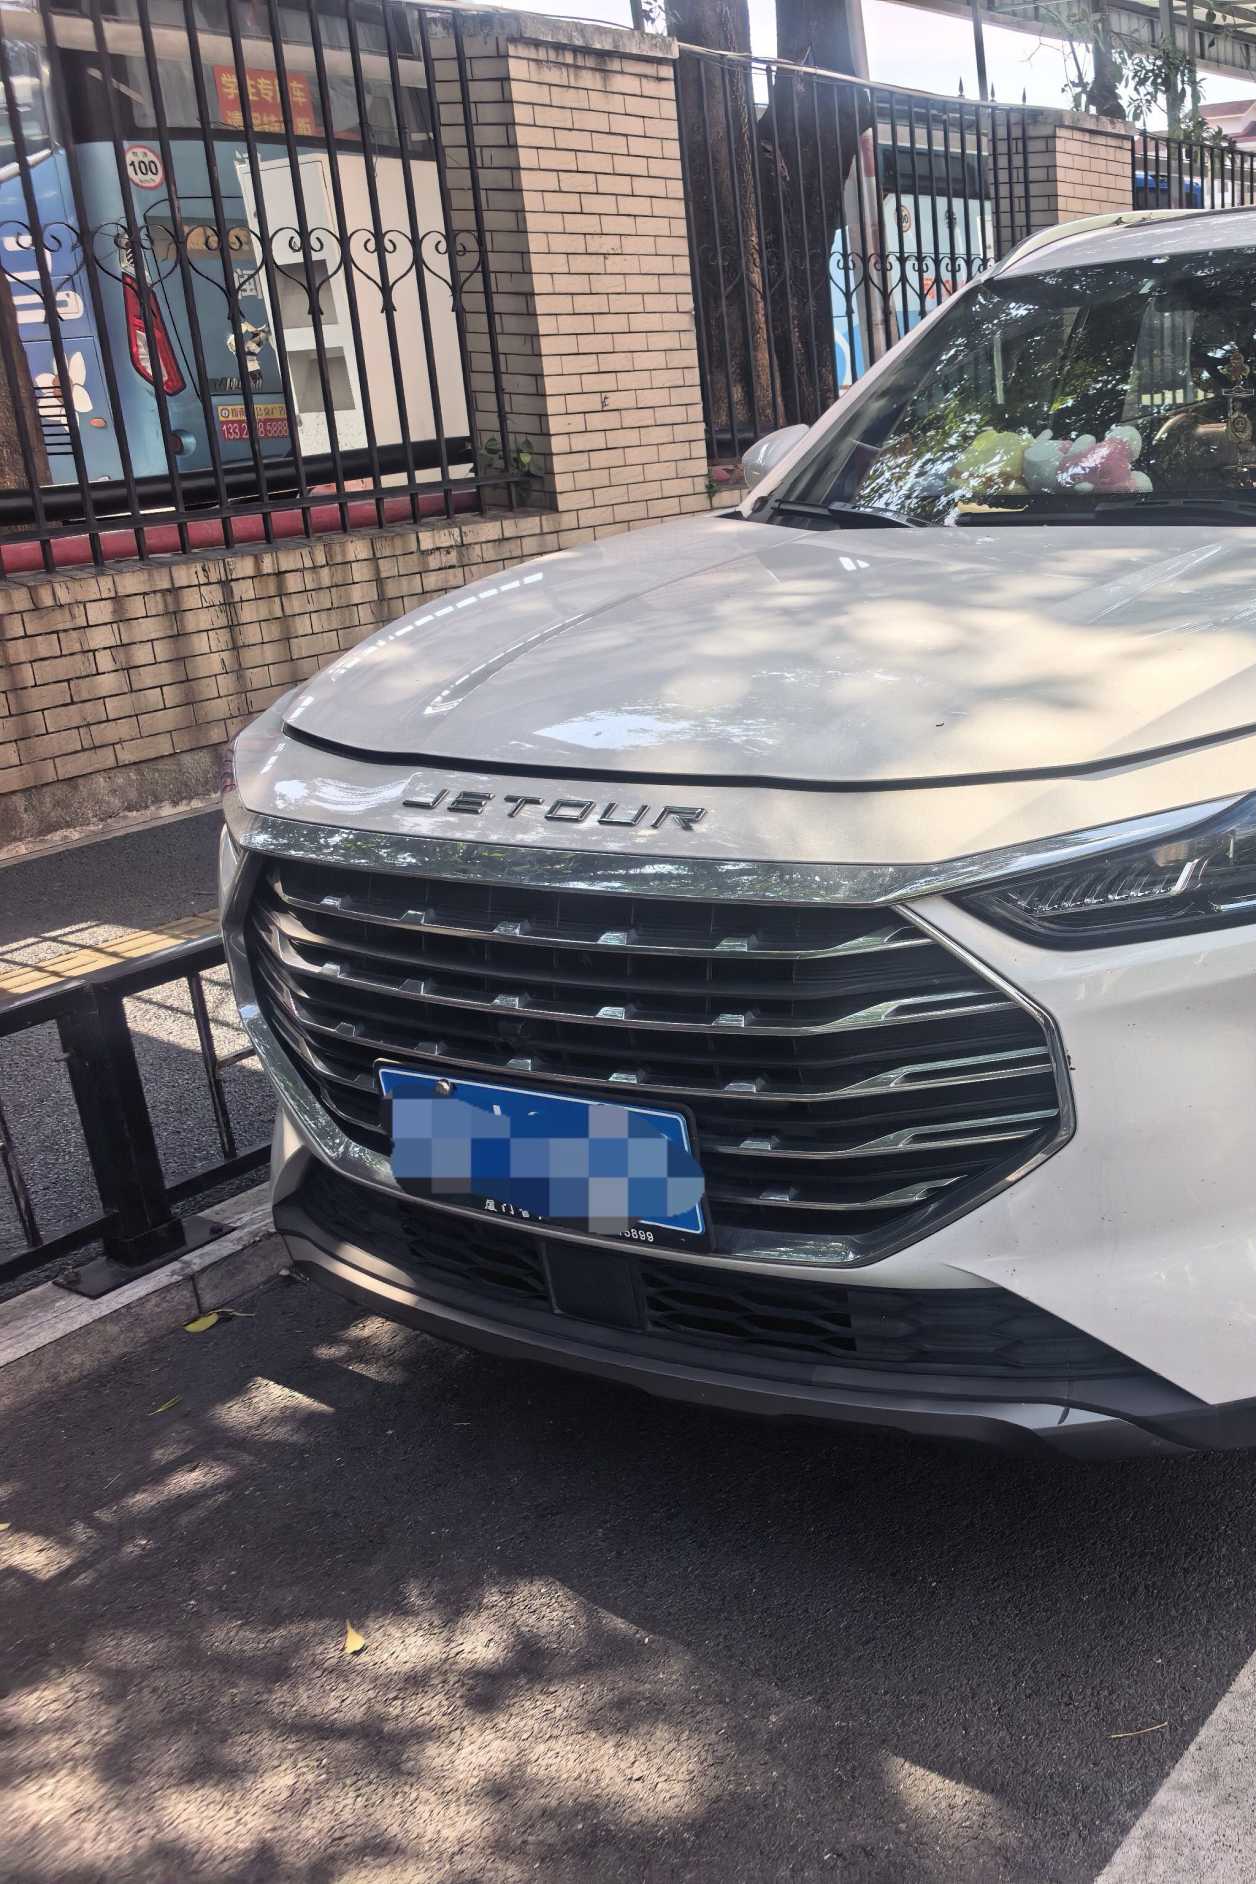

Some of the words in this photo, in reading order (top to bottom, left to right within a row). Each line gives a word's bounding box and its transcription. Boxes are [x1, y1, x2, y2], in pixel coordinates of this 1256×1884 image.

[221, 72, 306, 106] 学生专车
[129, 160, 159, 176] 100
[402, 788, 706, 831] JETOUR
